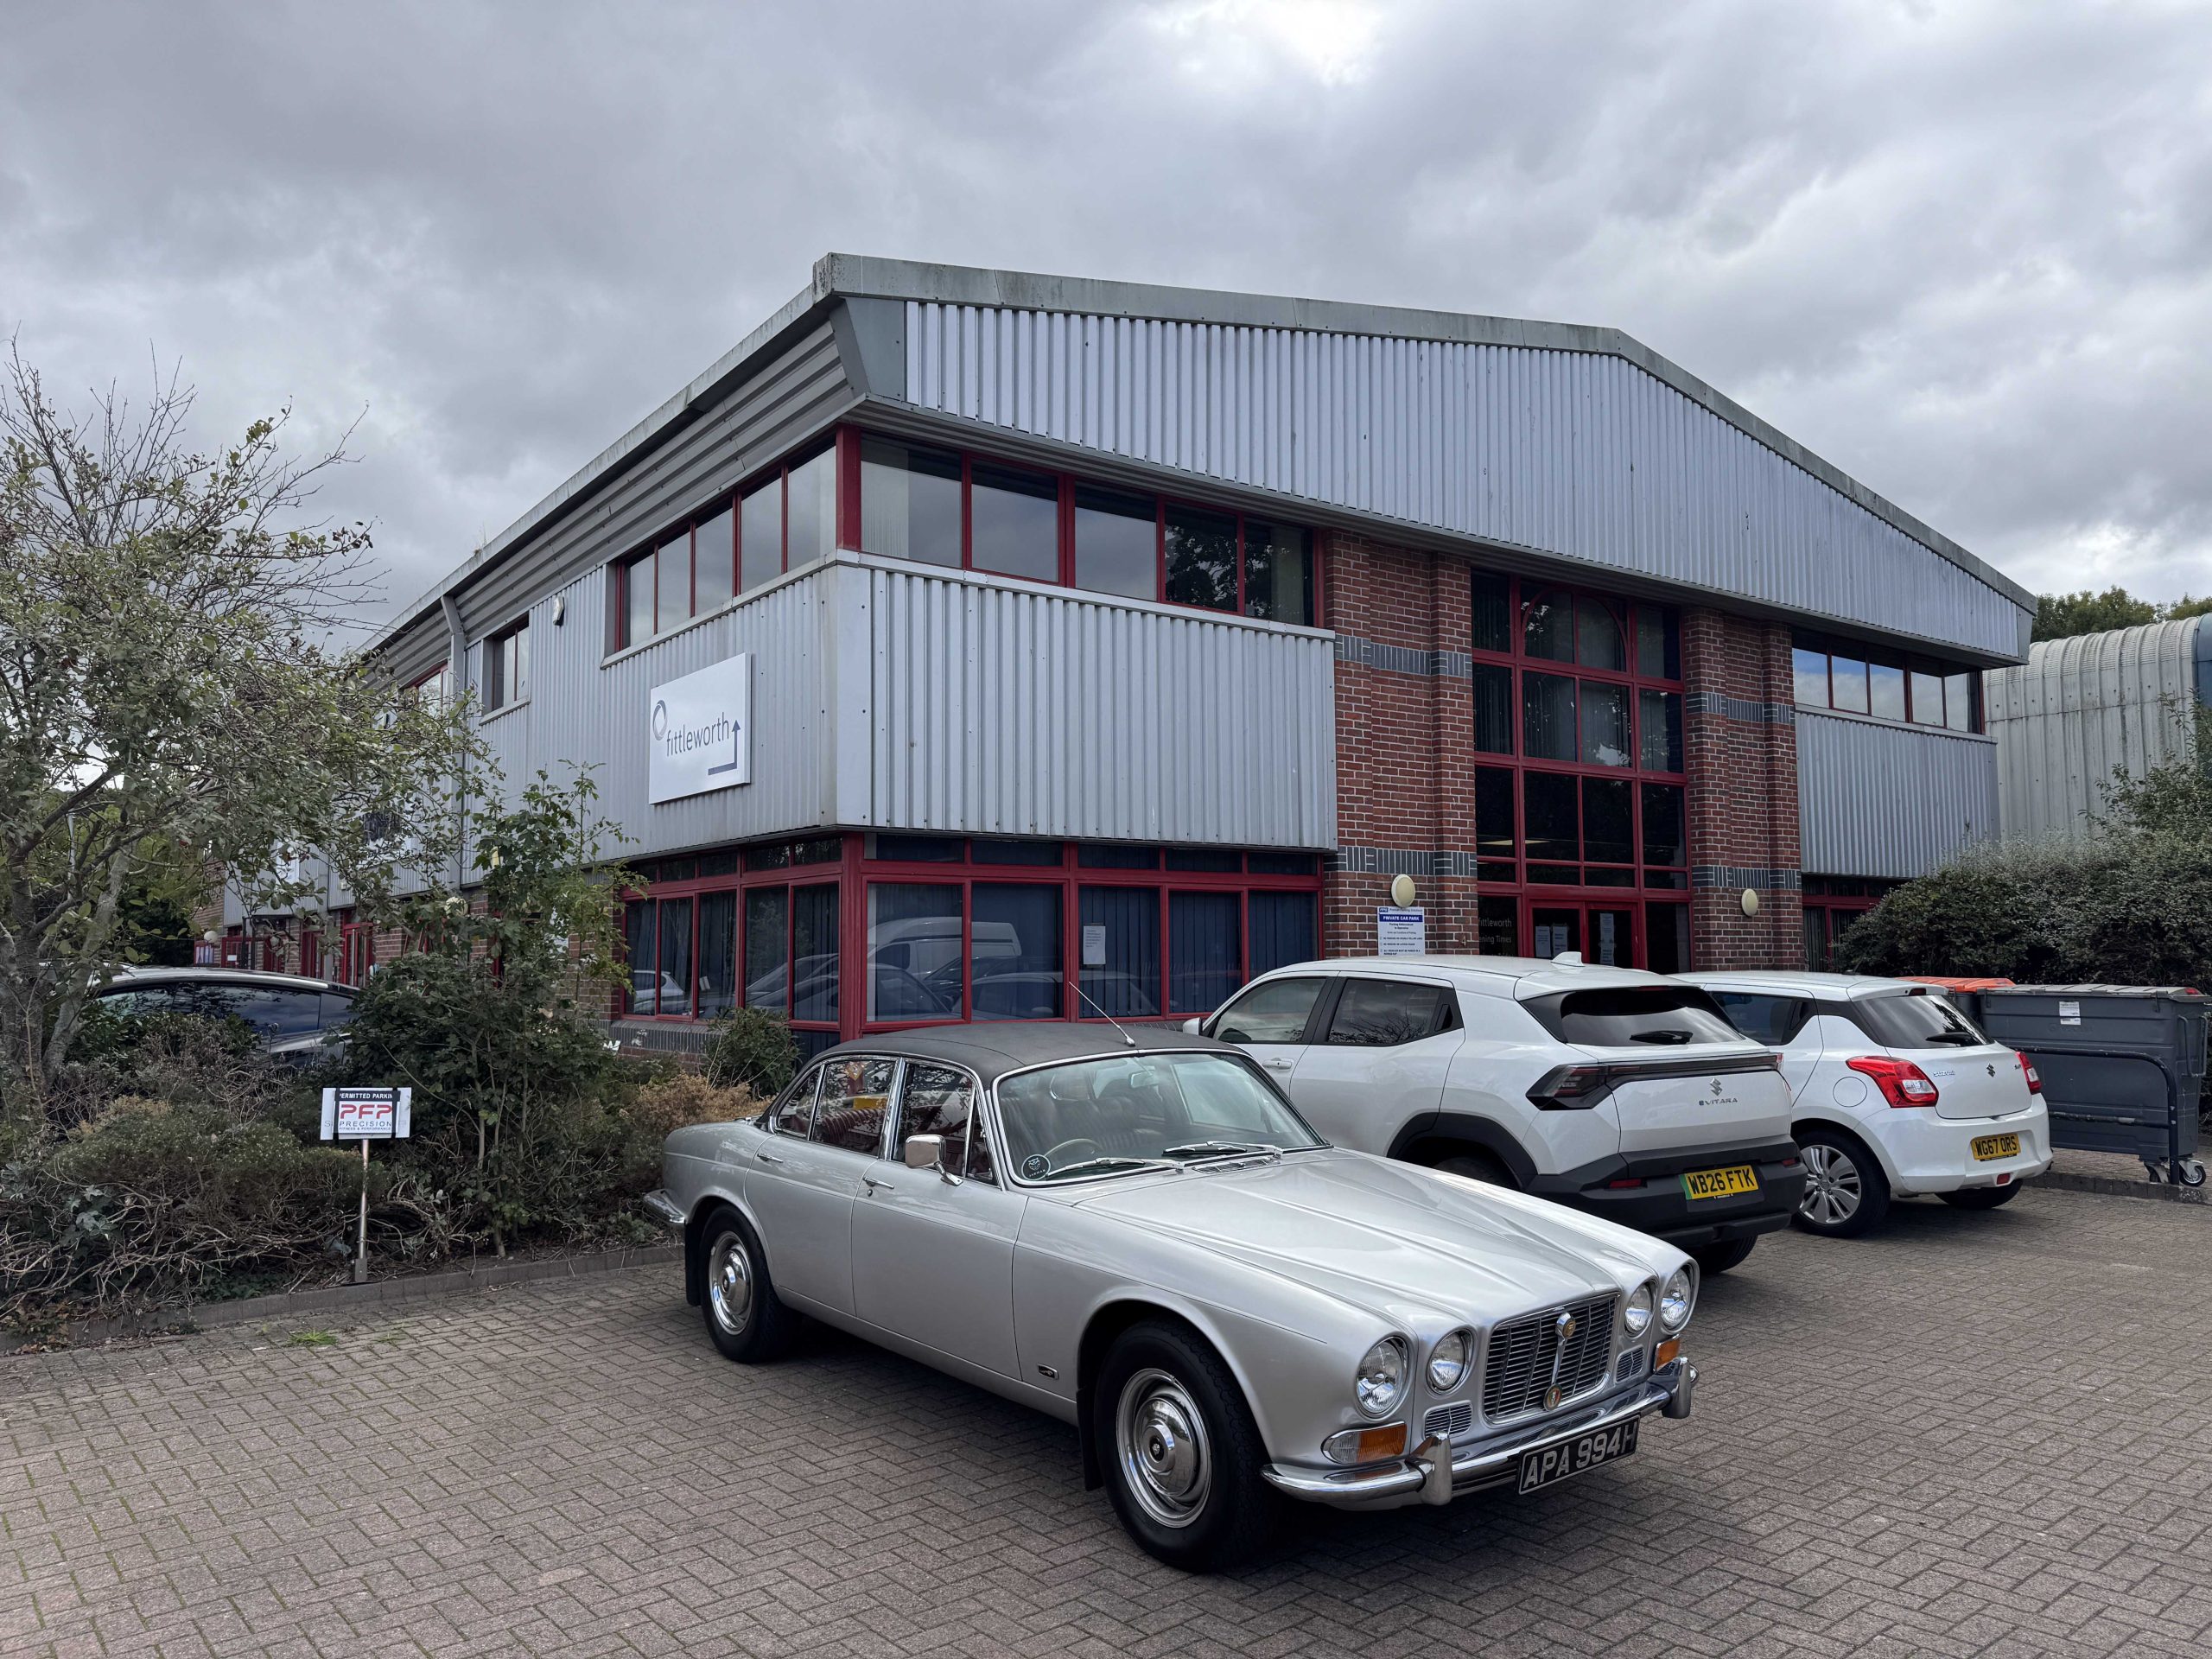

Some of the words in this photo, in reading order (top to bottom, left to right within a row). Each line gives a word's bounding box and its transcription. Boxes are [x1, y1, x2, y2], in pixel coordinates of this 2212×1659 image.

[666, 712, 729, 757] fittleworth
[1478, 917, 1512, 927] ittleworth
[1461, 936, 1467, 946] 4
[340, 1104, 392, 1119] PFP
[1974, 1138, 1999, 1157] WG67
[1688, 1173, 1726, 1195] WB26
[1725, 1167, 1755, 1190] FTK
[1523, 1445, 1570, 1488] APA
[1576, 1421, 1638, 1469] 994H
